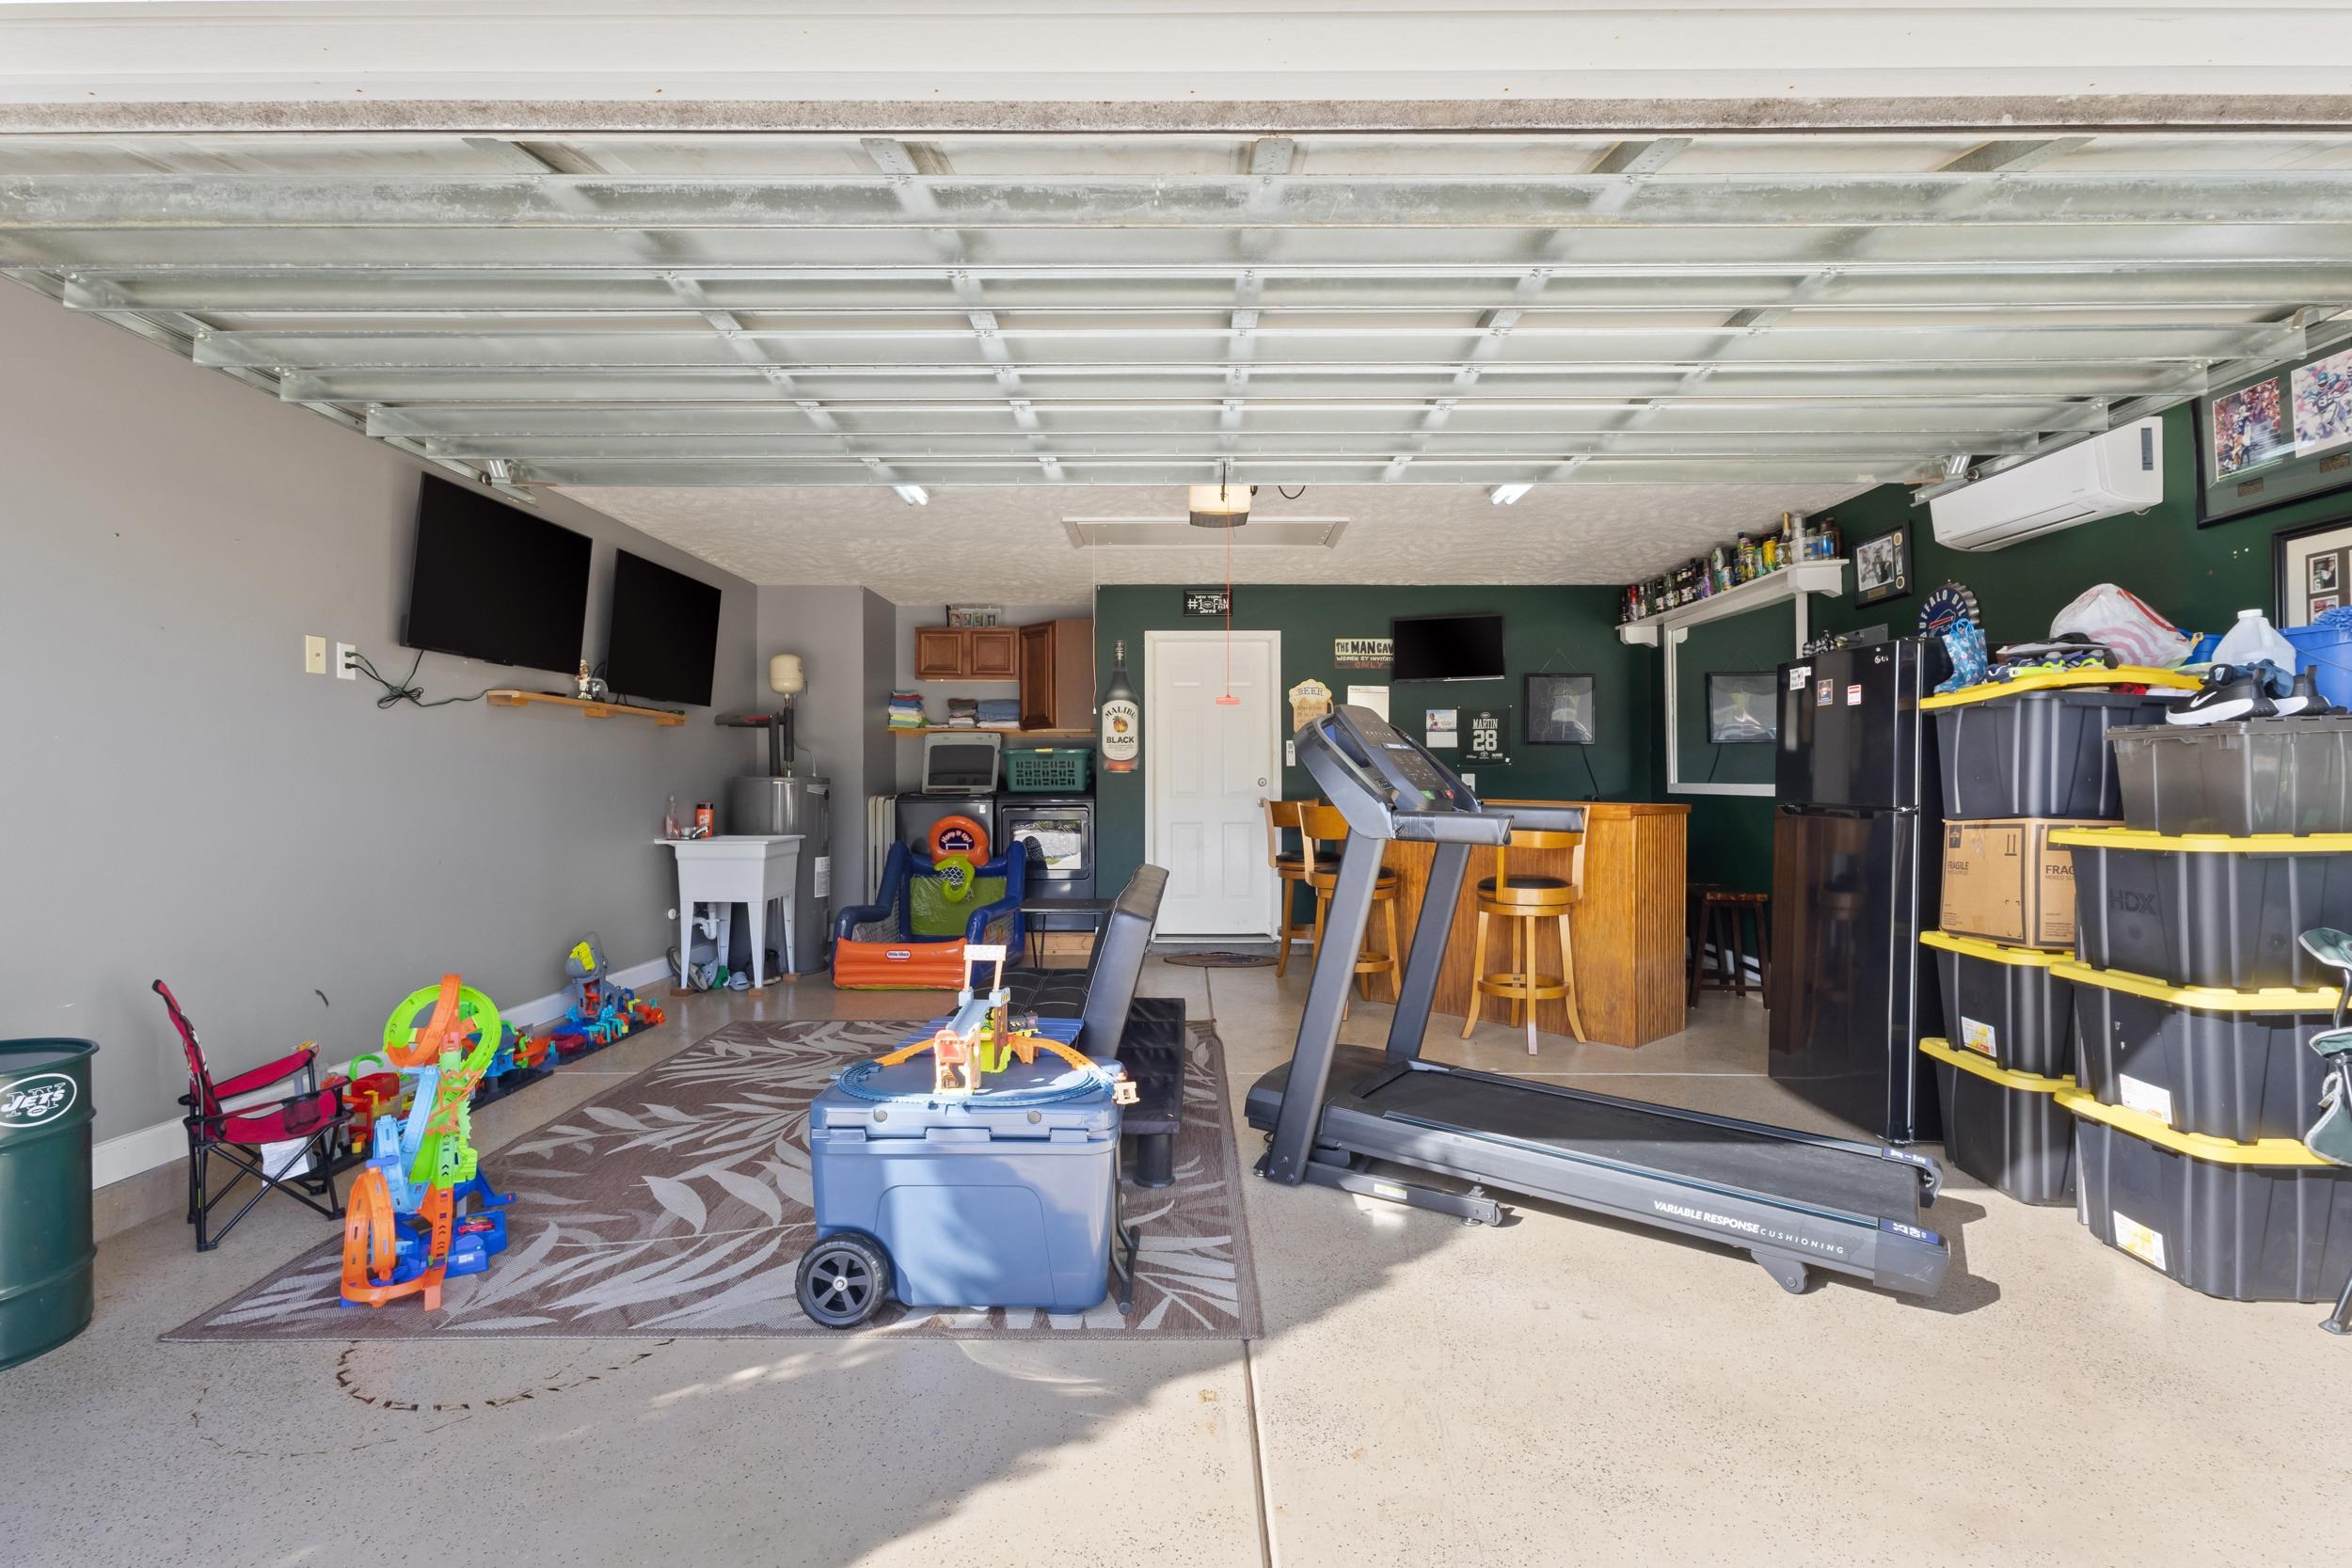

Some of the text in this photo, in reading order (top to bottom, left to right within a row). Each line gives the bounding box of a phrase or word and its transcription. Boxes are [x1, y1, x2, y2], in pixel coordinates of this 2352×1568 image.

[1187, 598, 1203, 610] #1
[1336, 642, 1349, 653] THE
[1351, 641, 1375, 654] MAN
[1297, 687, 1324, 696] BEER
[1104, 705, 1136, 720] MALIBU
[1472, 718, 1498, 730] MARTIN
[1472, 729, 1498, 752] 28
[1947, 861, 1970, 871] FRAGILE
[2109, 889, 2156, 915] HDX
[0, 1089, 66, 1112] JETS
[1654, 1200, 1844, 1254] VARIABLE RESPONSE CUSHIONING
